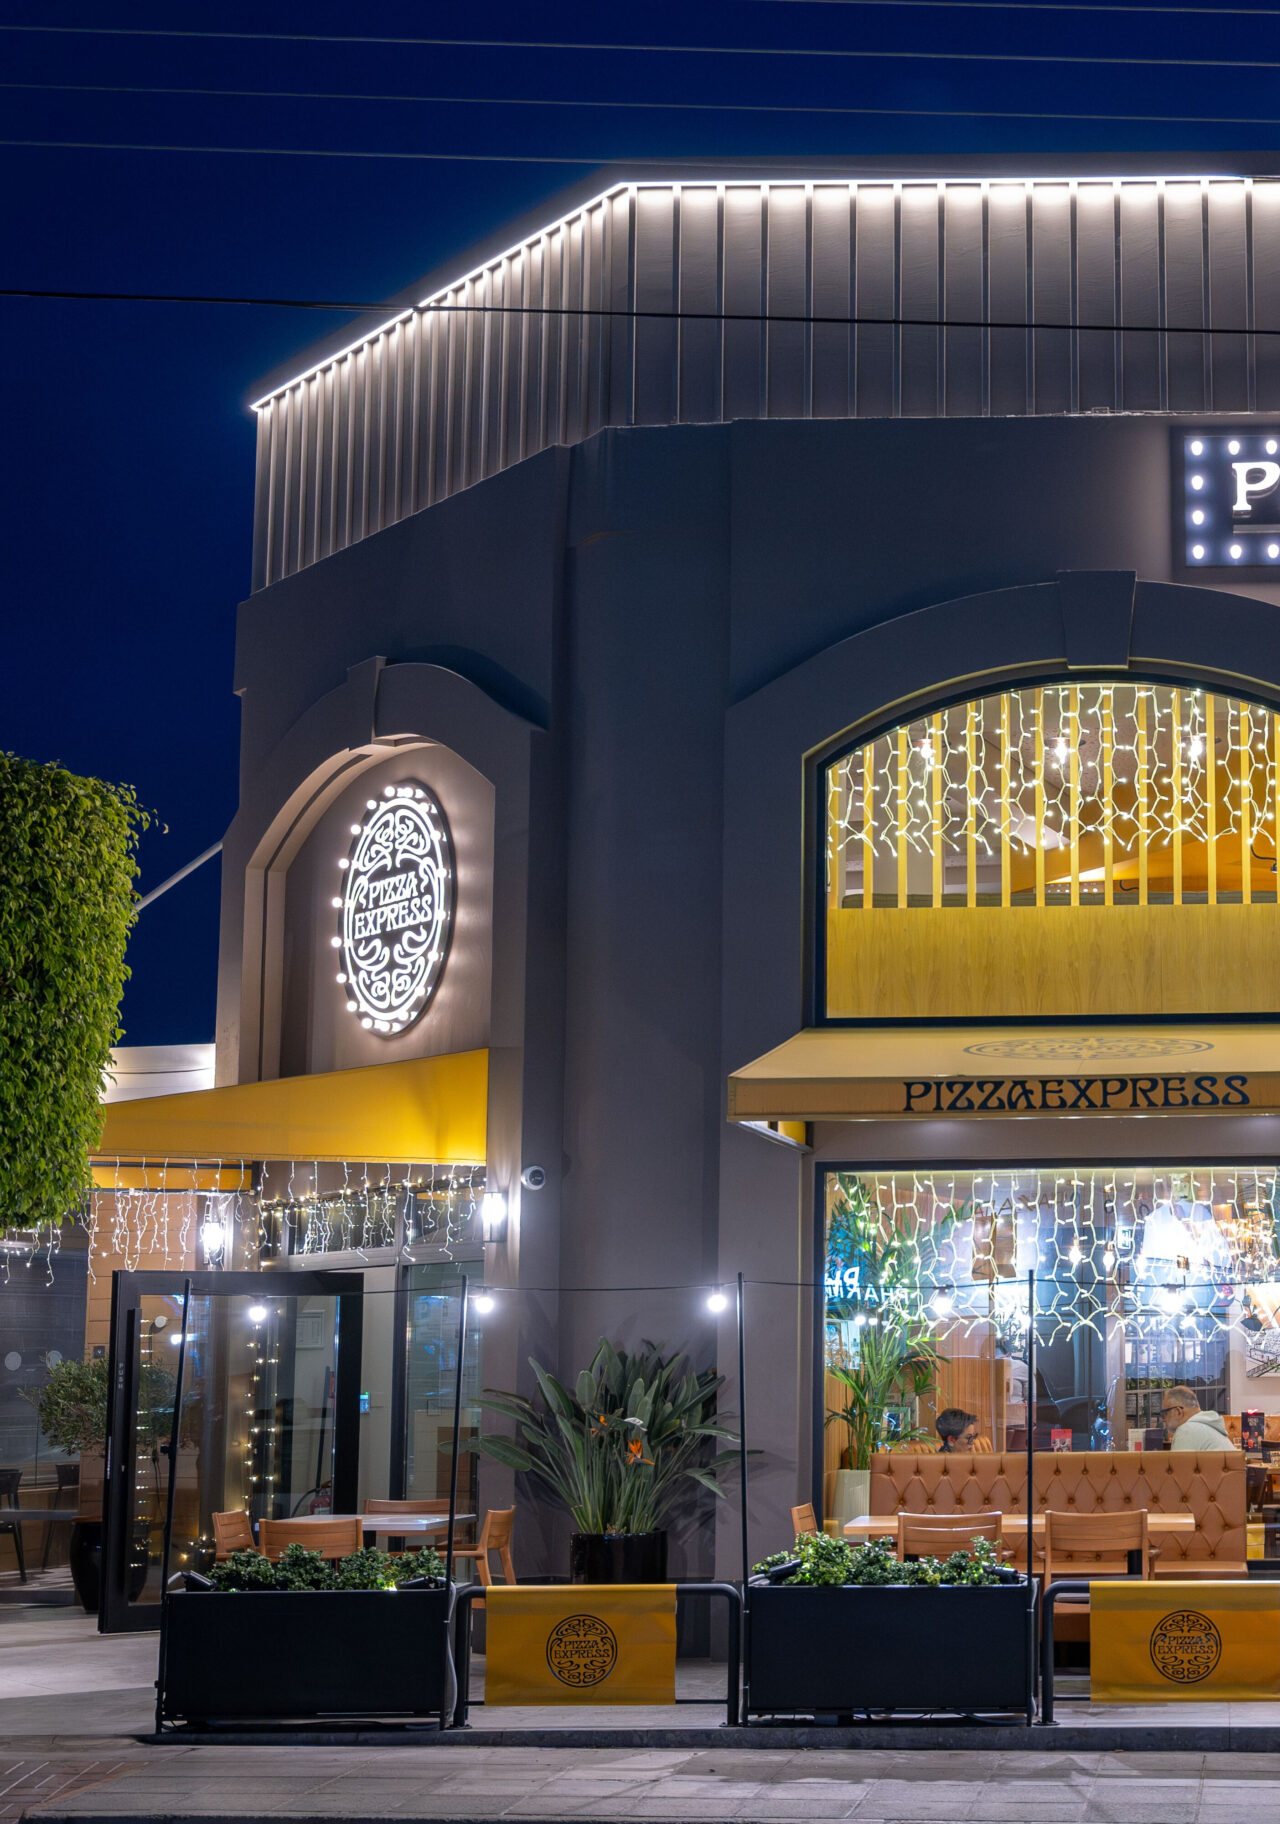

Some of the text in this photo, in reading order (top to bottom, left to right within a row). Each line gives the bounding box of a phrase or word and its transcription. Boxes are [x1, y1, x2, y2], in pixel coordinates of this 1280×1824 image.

[368, 871, 418, 909] PIZZA
[354, 895, 432, 940] EXPRESS
[563, 1639, 600, 1650] PIZZA
[1168, 1635, 1204, 1645] PIZZA
[553, 1649, 610, 1659] EXPRESS
[1157, 1645, 1214, 1654] EXPRESS
